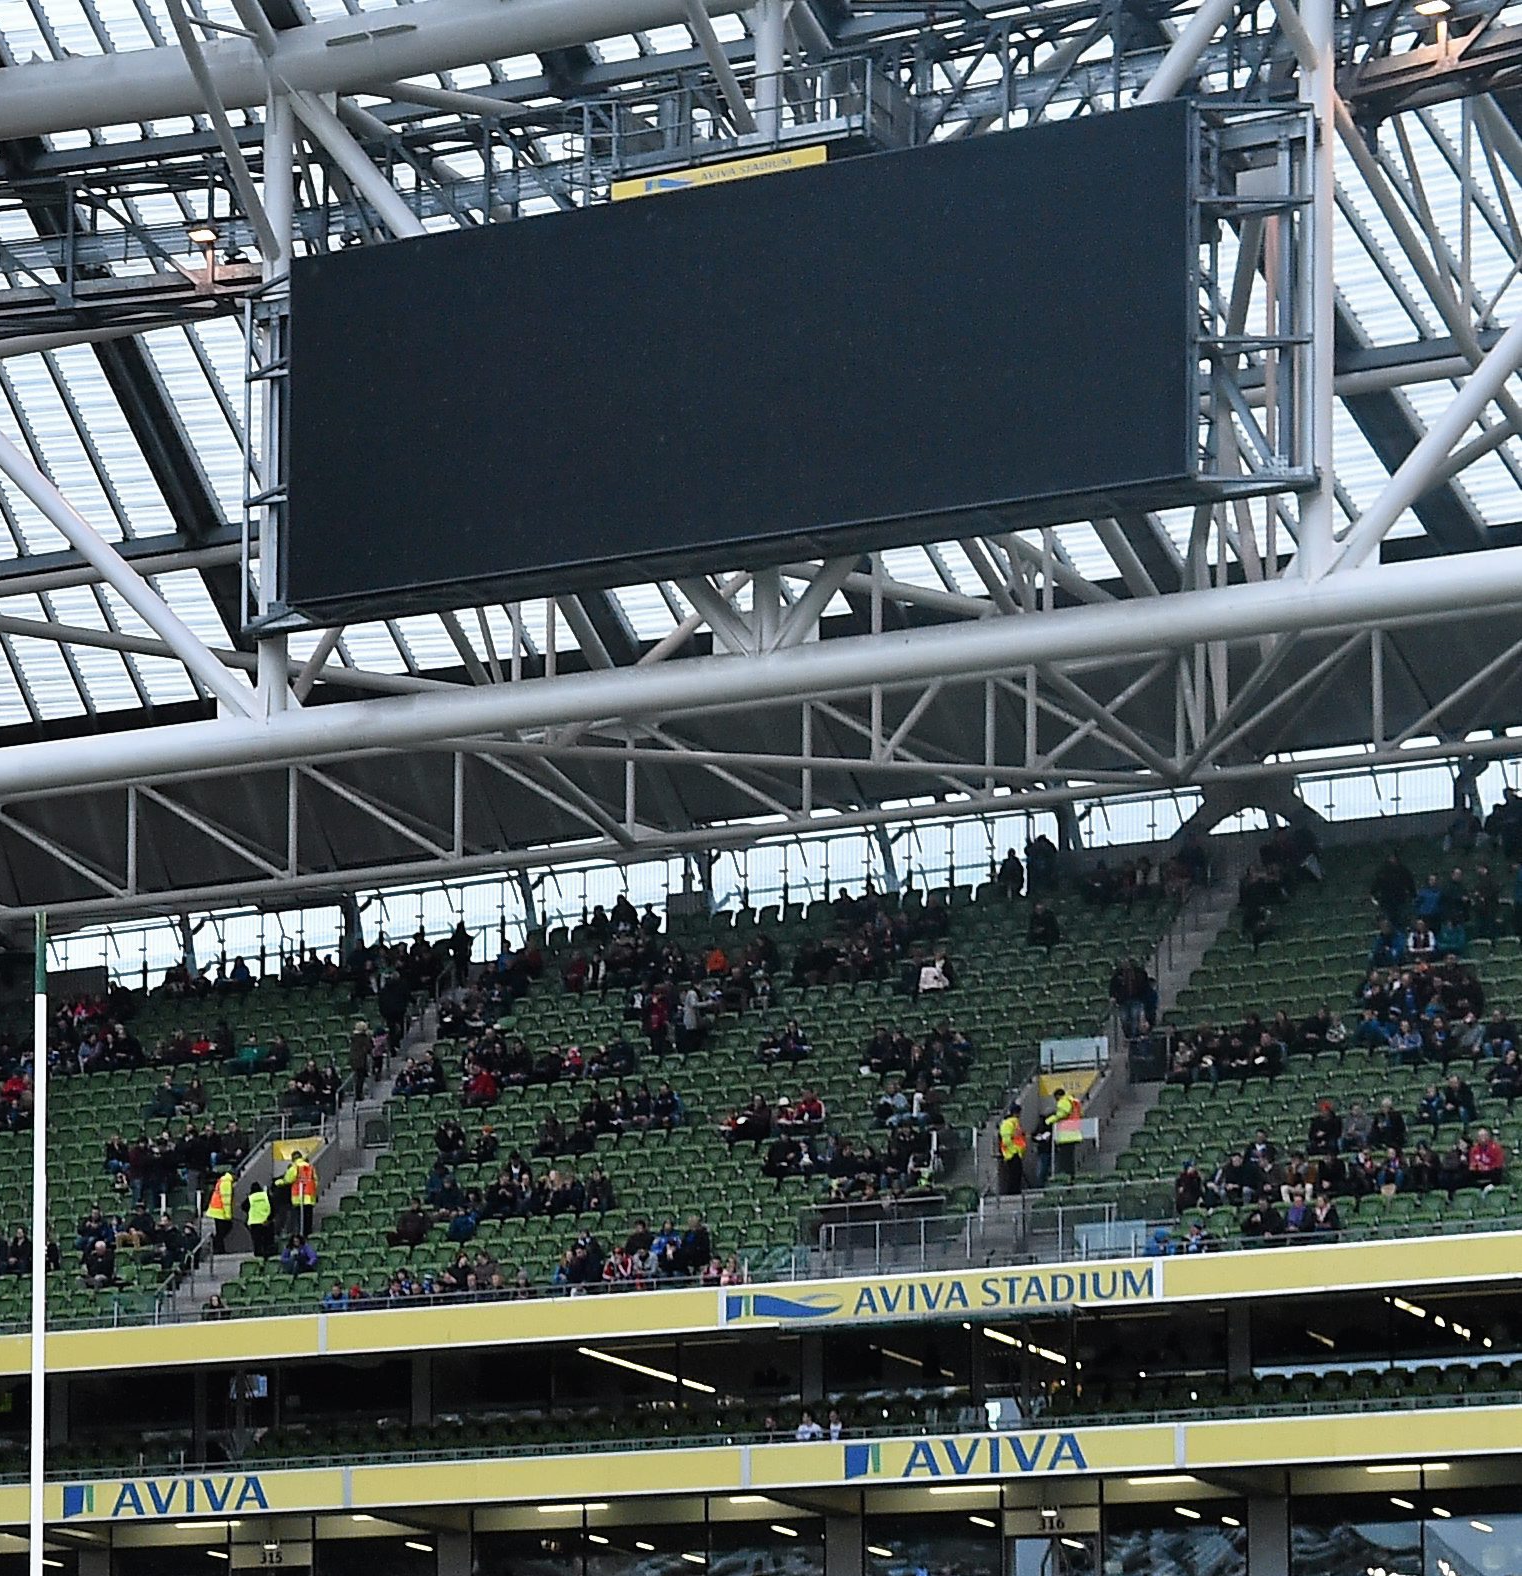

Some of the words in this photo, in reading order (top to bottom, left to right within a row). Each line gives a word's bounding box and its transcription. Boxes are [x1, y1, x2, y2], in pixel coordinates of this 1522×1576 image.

[853, 1279, 970, 1316] AVIVA
[980, 1267, 1156, 1307] STADIUM
[902, 1432, 1089, 1478] AVIVA
[111, 1474, 269, 1518] AVIVA
